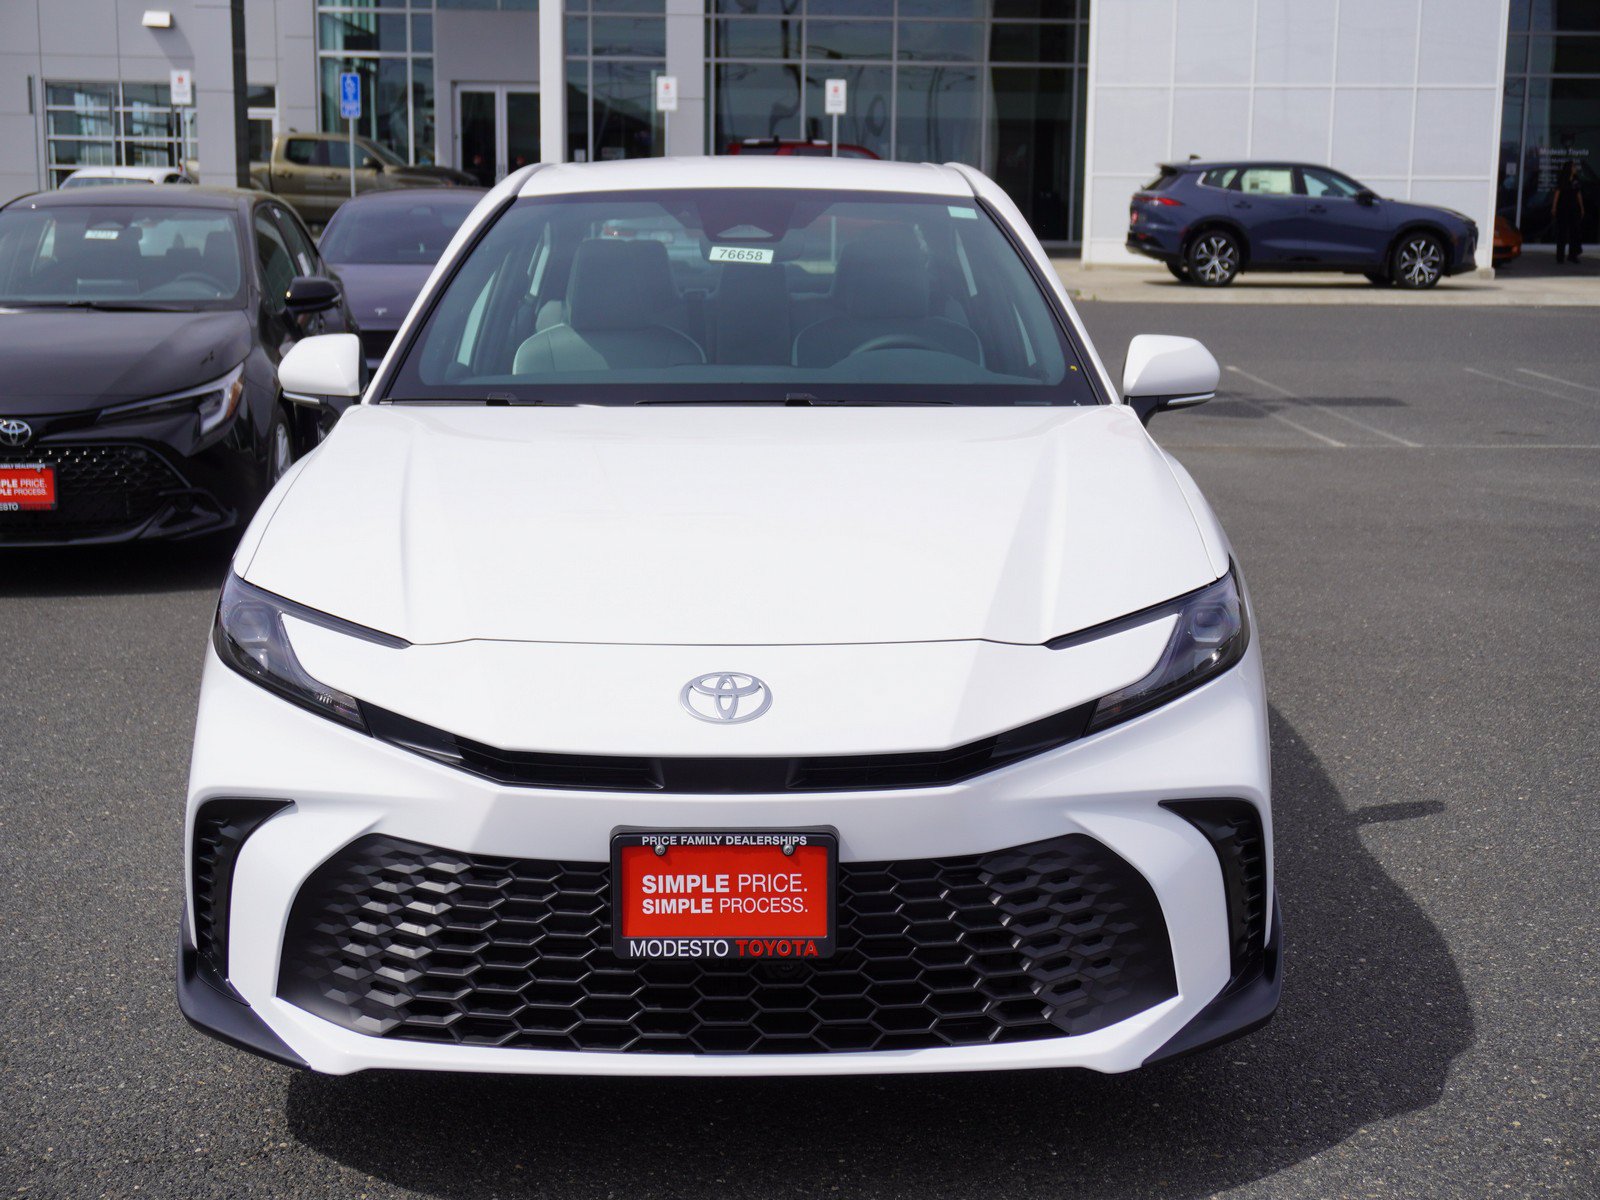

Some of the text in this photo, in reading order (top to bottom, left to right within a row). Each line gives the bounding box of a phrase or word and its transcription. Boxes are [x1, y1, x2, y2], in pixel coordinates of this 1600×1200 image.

[720, 249, 763, 261] 76658
[0, 478, 48, 488] PLE PRICE.
[642, 836, 807, 845] PRICE FAMILY DEALERSHIPS
[642, 873, 808, 893] SIMPLE PRICE.
[642, 897, 808, 914] SIMPLE PROCESS.
[629, 940, 819, 957] MODESTO TOYOTA
